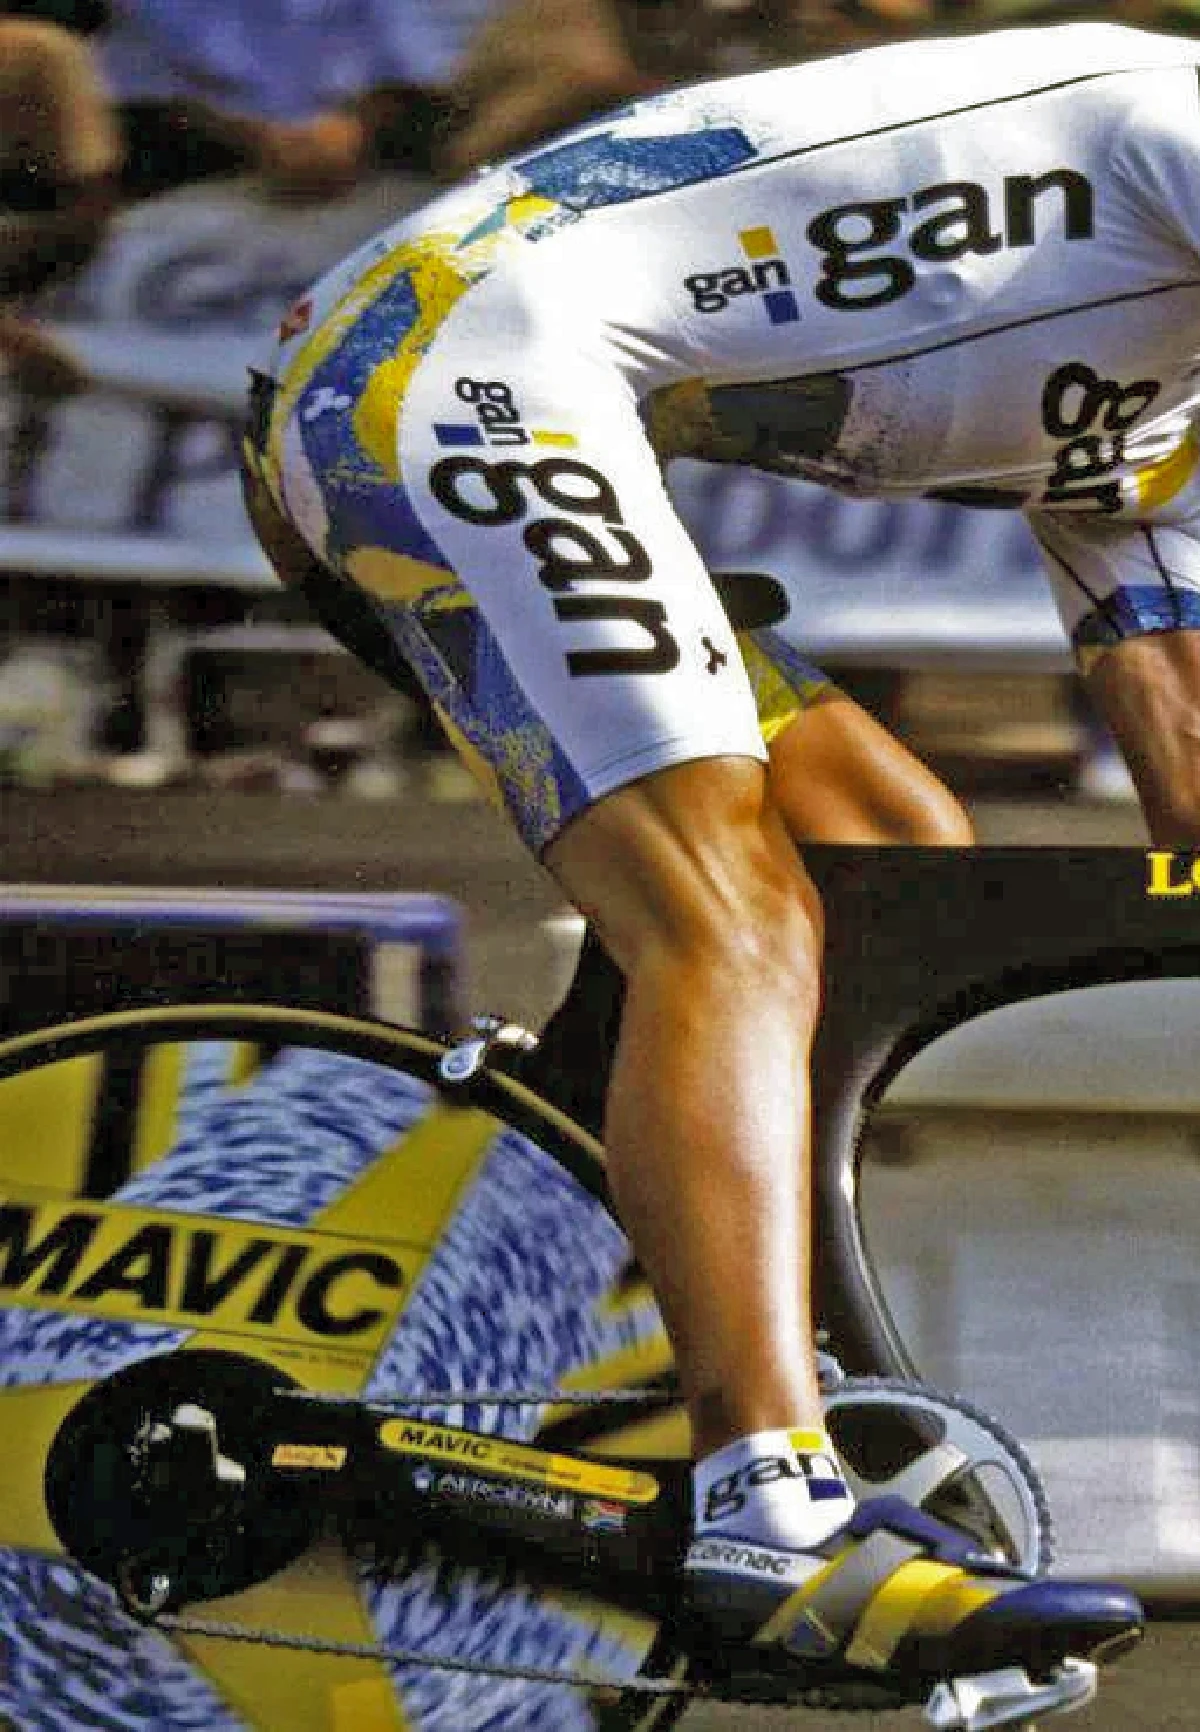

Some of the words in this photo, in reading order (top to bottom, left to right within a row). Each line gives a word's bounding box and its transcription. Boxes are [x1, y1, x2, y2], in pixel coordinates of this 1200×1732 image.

[806, 168, 1095, 310] gan
[683, 257, 789, 314] gan
[455, 376, 530, 446] gan
[428, 455, 681, 678] gan
[0, 1203, 404, 1336] MAVIC
[399, 1426, 493, 1460] MAVIC
[706, 1452, 842, 1522] gan
